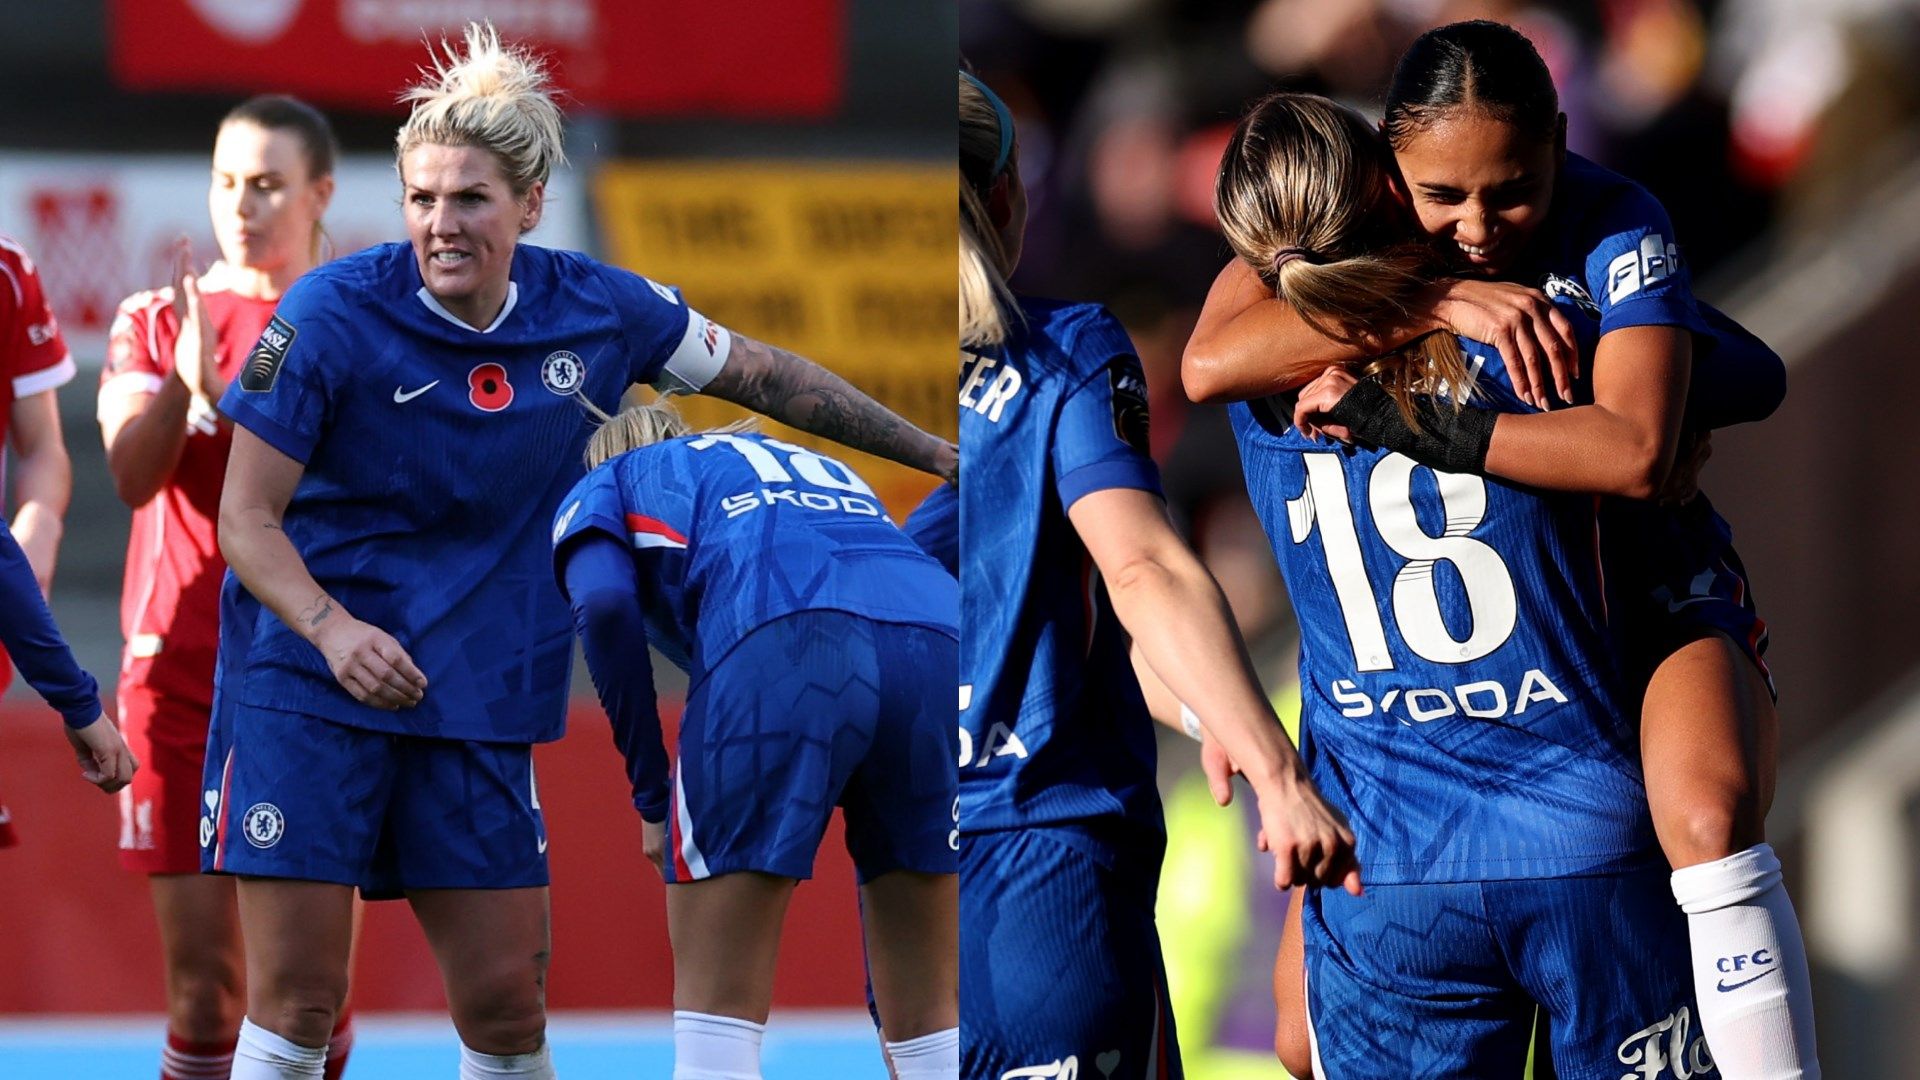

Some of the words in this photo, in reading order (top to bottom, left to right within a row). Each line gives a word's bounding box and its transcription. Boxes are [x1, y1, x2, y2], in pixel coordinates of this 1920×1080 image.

[687, 434, 878, 499] 18
[720, 488, 900, 530] SKOD
[1286, 451, 1517, 672] 18
[1716, 948, 1773, 972] CFC
